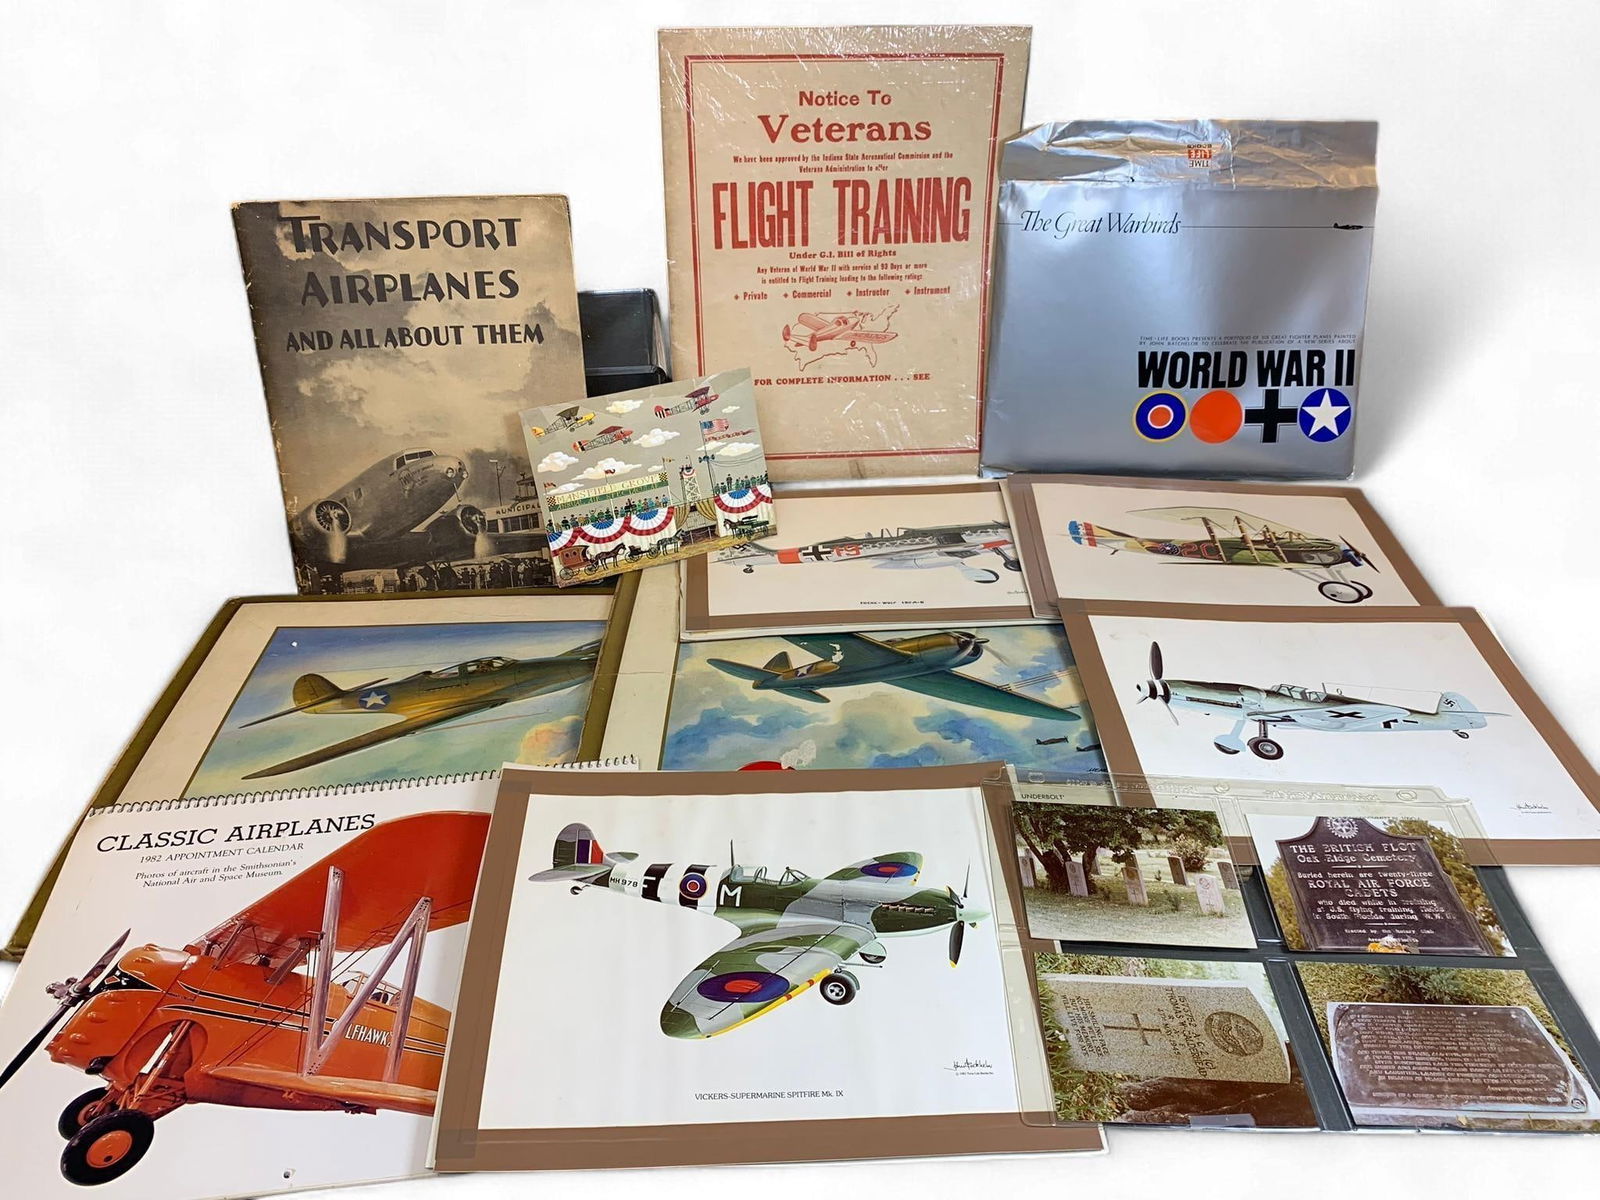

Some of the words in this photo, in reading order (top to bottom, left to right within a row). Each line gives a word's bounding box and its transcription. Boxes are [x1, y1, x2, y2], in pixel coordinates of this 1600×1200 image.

[798, 90, 860, 106] Notice
[866, 89, 892, 105] To
[757, 114, 932, 144] Veterans
[733, 155, 742, 163] We
[744, 155, 757, 163] have
[759, 154, 773, 163] been
[775, 154, 801, 164] approved
[802, 154, 809, 163] by
[811, 154, 820, 162] the
[822, 153, 843, 161] Indiana
[845, 153, 859, 161] State
[861, 152, 896, 160] Aeronautical
[898, 152, 930, 160] Commission
[944, 151, 953, 159] the
[1188, 160, 1209, 168] TIME
[799, 165, 823, 173] Veterans
[825, 164, 865, 173] Administration
[867, 164, 873, 172] to
[712, 180, 814, 249] FLIGHT
[833, 176, 972, 246] TRAINING
[1020, 210, 1052, 232] The
[1054, 210, 1103, 240] Great
[1107, 211, 1182, 235] Warbirds
[280, 215, 521, 255] TRANSPORT
[789, 251, 817, 259] Under
[819, 250, 835, 258] G.I.
[837, 250, 854, 258] Bill
[856, 250, 865, 258] of
[868, 249, 897, 258] Rights
[757, 266, 767, 274] Any
[792, 265, 798, 273] of
[873, 263, 879, 271] of
[890, 263, 902, 271] Days
[768, 276, 789, 284] entitled
[798, 276, 814, 284] Flight
[816, 275, 838, 283] Training
[878, 273, 903, 281] following
[301, 269, 519, 308] AIRPLANES
[743, 291, 768, 300] Private
[792, 289, 832, 299] Commercial
[855, 288, 890, 297] Instructor
[914, 286, 950, 295] Instrument
[286, 330, 333, 353] AND
[340, 327, 380, 350] ALL
[384, 325, 465, 350] ABOUT
[472, 323, 544, 345] THEM
[1138, 350, 1248, 389] WORLD
[1256, 349, 1326, 388] WAR
[1334, 349, 1356, 387] II
[754, 378, 773, 386] FOR
[776, 376, 824, 385] COMPLETE
[827, 374, 891, 384] INFORMATION
[913, 373, 931, 381] SEE
[96, 828, 218, 852] CLASSIC
[224, 813, 376, 843] AIRPLANES
[140, 854, 162, 864] 1982
[165, 848, 244, 862] APPOINTMENT
[246, 842, 304, 856] CALENDAR
[1289, 844, 1316, 854] THE
[1322, 843, 1375, 853] BRITISH
[1297, 854, 1320, 863] Oak
[1325, 854, 1357, 864] Ridge
[1363, 853, 1417, 863] Cemetery
[135, 870, 165, 880] Photos
[167, 869, 178, 878] of
[179, 867, 209, 876] aircraft
[211, 866, 221, 874] in
[223, 865, 237, 873] the
[239, 859, 297, 872] Smithsonian's
[1297, 871, 1323, 879] Buried
[1378, 870, 1433, 879] twenty-three
[142, 877, 181, 888] National
[182, 876, 198, 885] Air
[199, 875, 216, 884] and
[218, 872, 244, 882] Space
[1308, 880, 1350, 889] ROYAL
[1358, 879, 1381, 888] AIR
[1387, 878, 1431, 888] FORCE
[719, 884, 743, 908] M
[1345, 888, 1398, 898] CADETS
[1379, 905, 1414, 914] training
[1390, 913, 1419, 921] during
[340, 1021, 391, 1047] LFHAWK
[695, 1091, 786, 1101] VICKERS-SUPERMARINE
[787, 1090, 821, 1099] SPITFIRE
